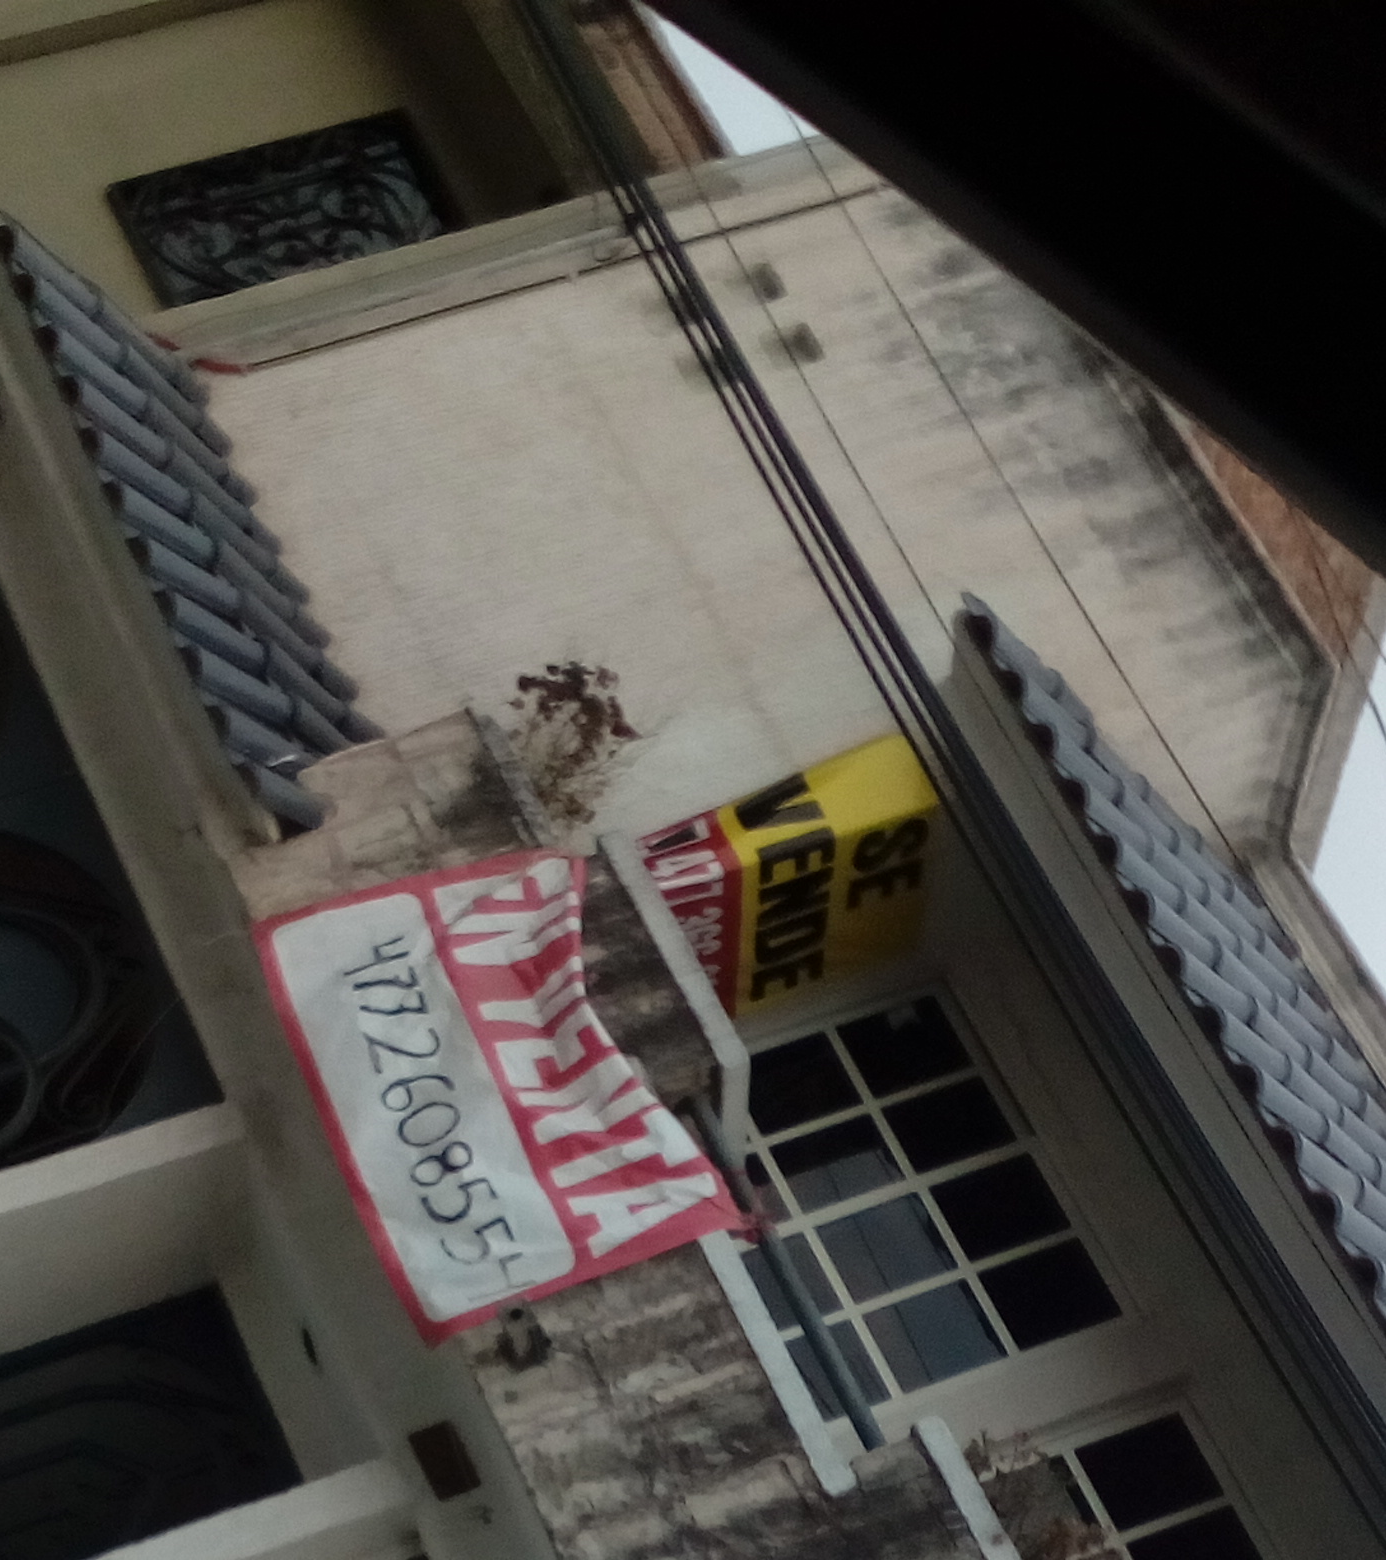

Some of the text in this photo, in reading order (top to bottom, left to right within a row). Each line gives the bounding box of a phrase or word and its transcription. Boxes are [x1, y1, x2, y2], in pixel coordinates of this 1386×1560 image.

[649, 849, 726, 908] 477
[734, 770, 838, 1003] VENDE
[846, 817, 930, 911] SE
[433, 857, 719, 1259] EN VENTA
